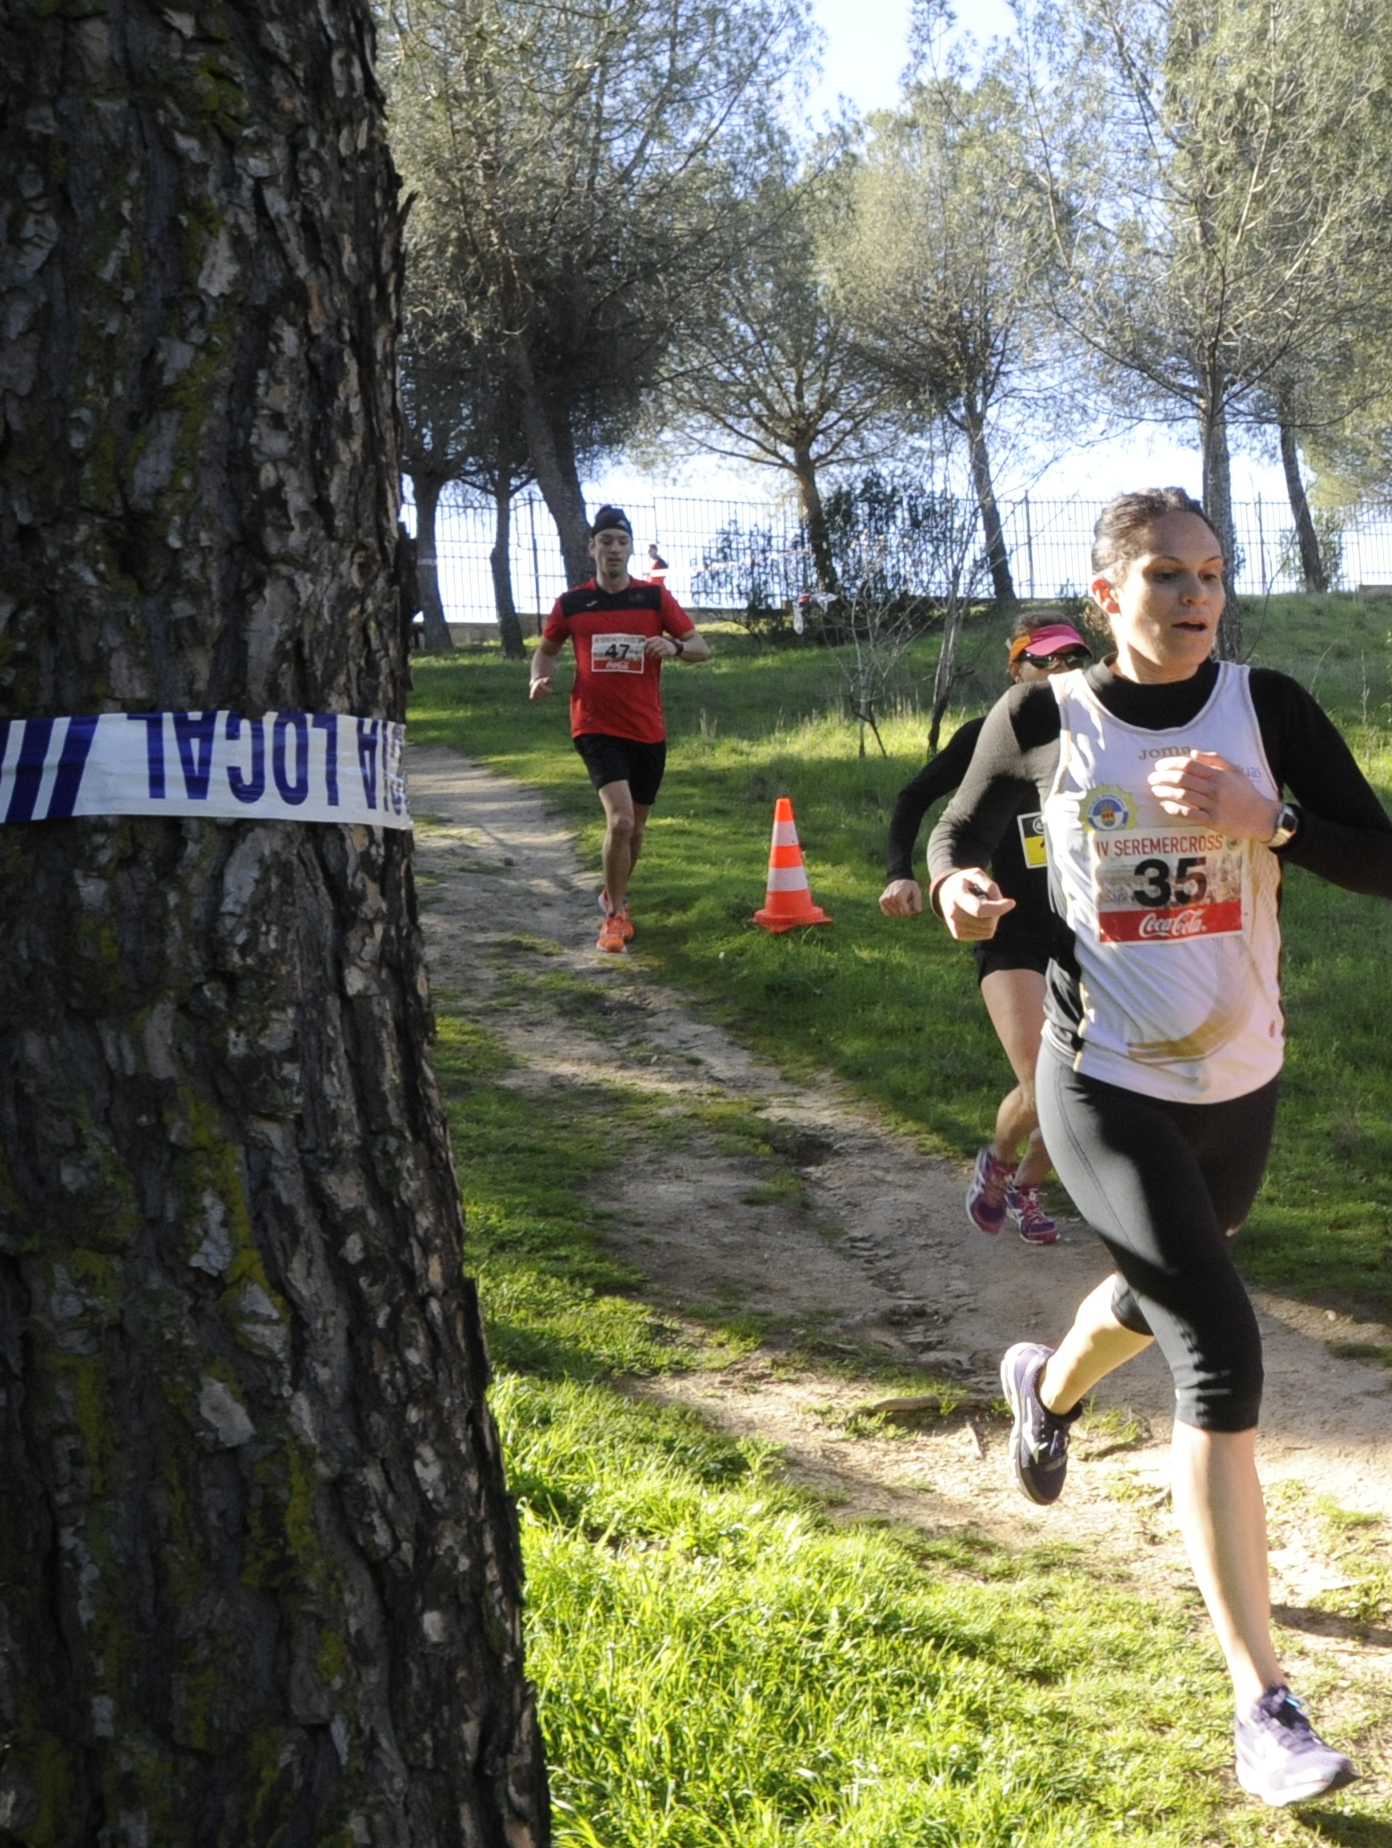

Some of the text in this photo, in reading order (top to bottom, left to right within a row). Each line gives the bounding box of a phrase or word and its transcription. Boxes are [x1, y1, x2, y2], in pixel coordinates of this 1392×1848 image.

[605, 643, 631, 660] 47
[126, 710, 339, 806] LOCAL
[1096, 834, 1224, 857] IV SEREMERCROSS
[1133, 856, 1207, 908] 35
